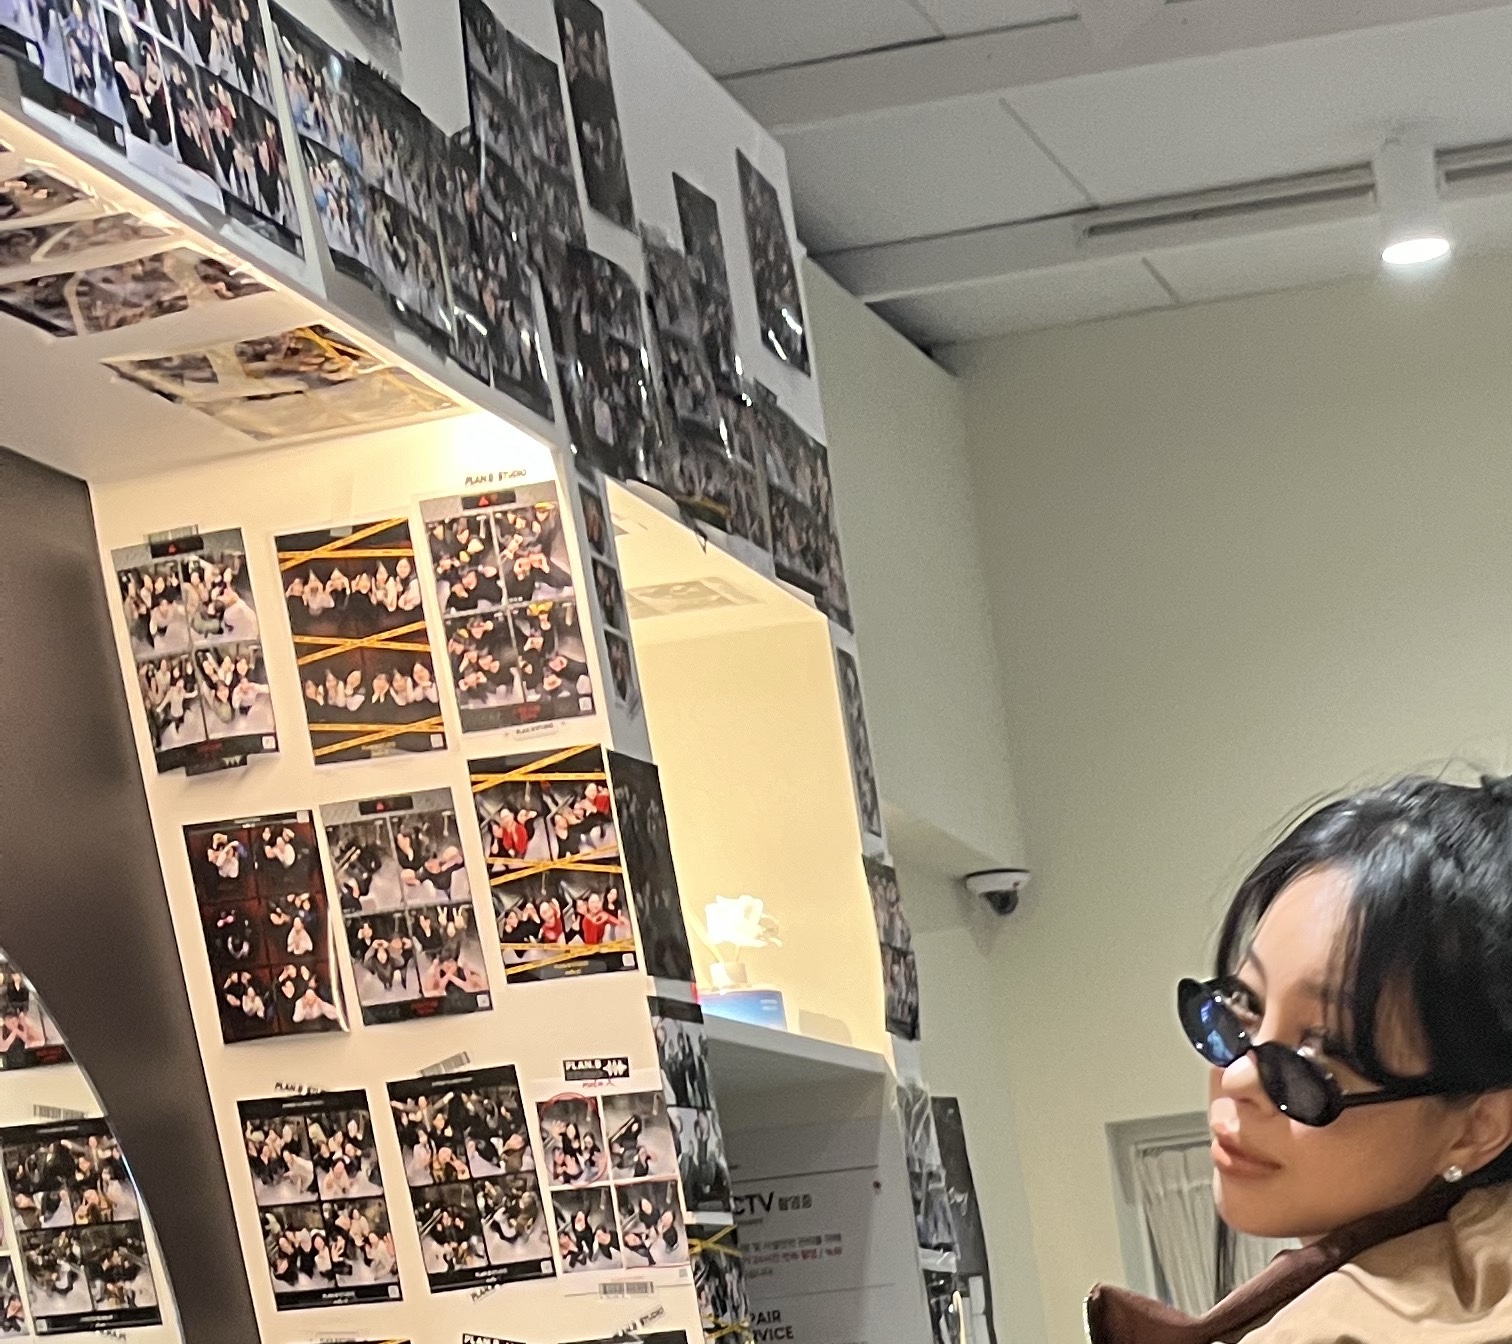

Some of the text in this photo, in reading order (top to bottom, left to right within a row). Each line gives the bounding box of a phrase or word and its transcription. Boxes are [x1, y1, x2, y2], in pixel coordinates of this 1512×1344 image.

[732, 1191, 774, 1215] CTV
[749, 1310, 782, 1324] PAIR
[752, 1326, 794, 1342] RVICE
